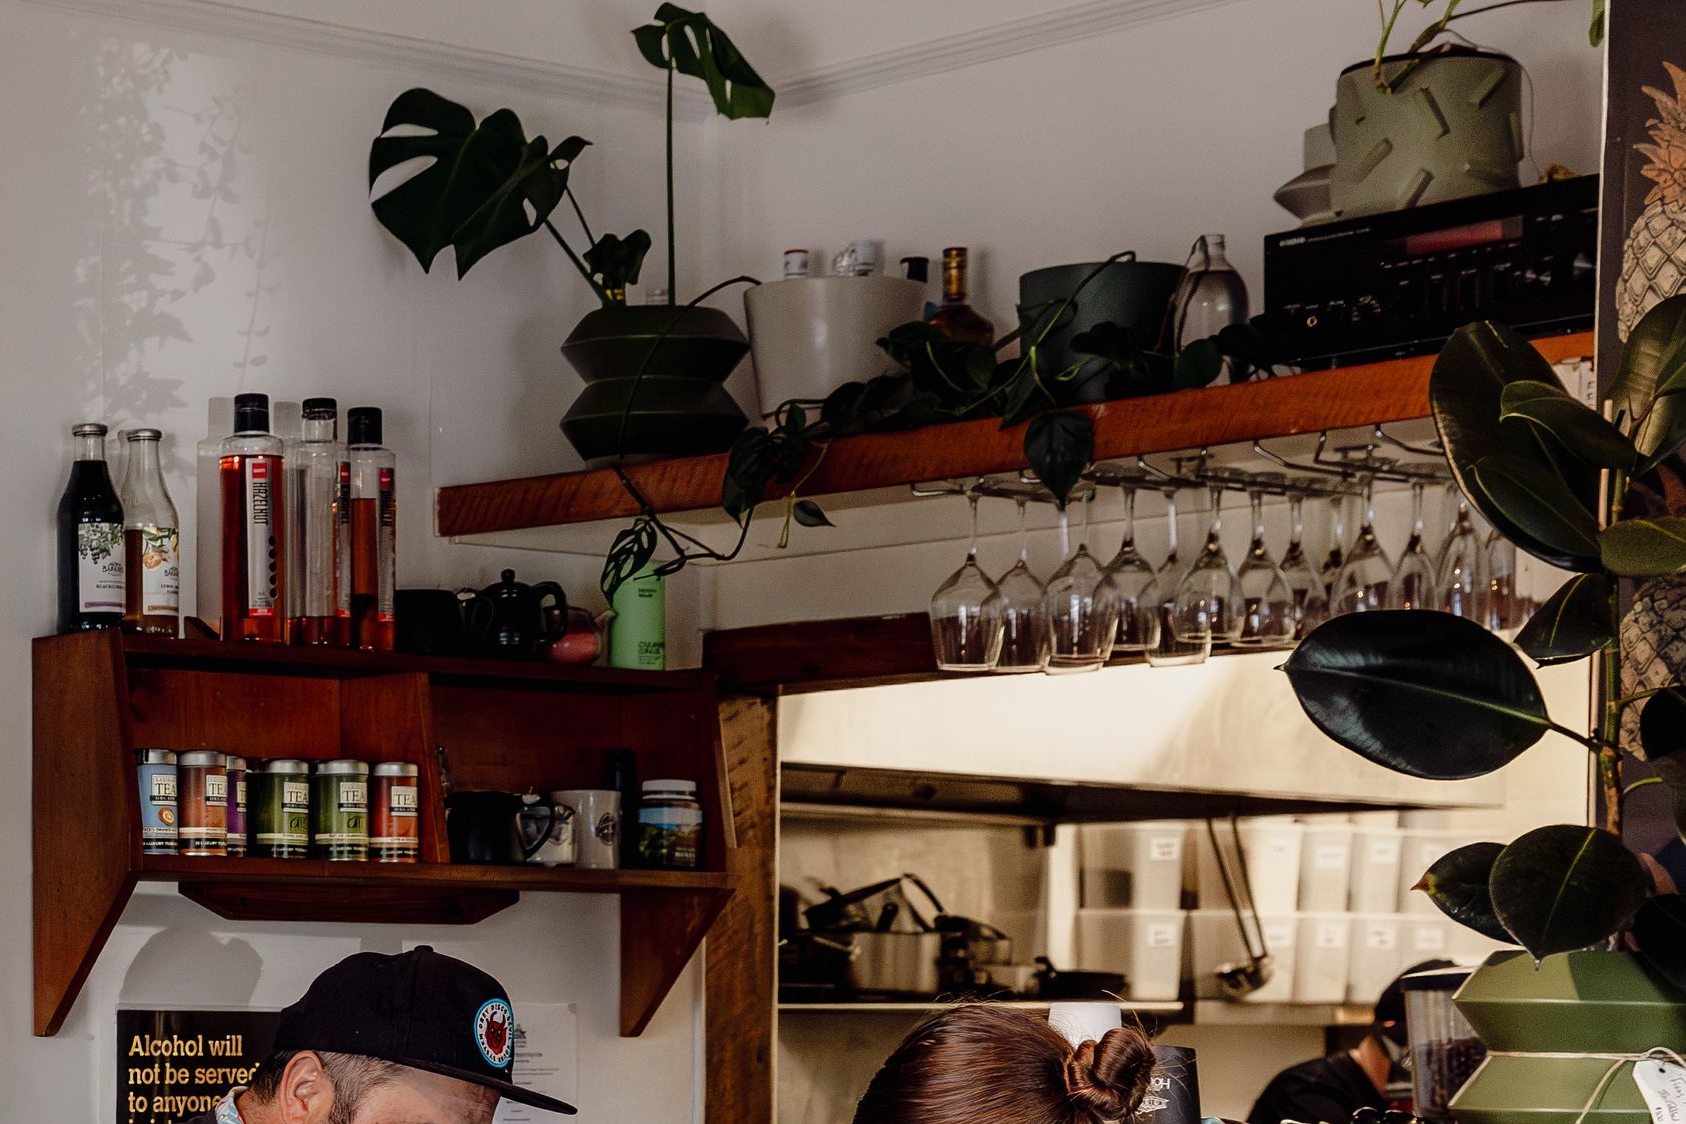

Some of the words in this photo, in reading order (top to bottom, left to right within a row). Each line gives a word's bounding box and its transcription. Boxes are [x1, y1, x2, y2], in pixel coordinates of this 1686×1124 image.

[252, 482, 268, 526] HAZELNUT
[209, 783, 227, 796] TE
[287, 790, 309, 804] TEA
[128, 1034, 204, 1057] Alcohol
[208, 1034, 243, 1057] will
[128, 1063, 161, 1085] not
[165, 1062, 190, 1085] be
[128, 1091, 148, 1113] to
